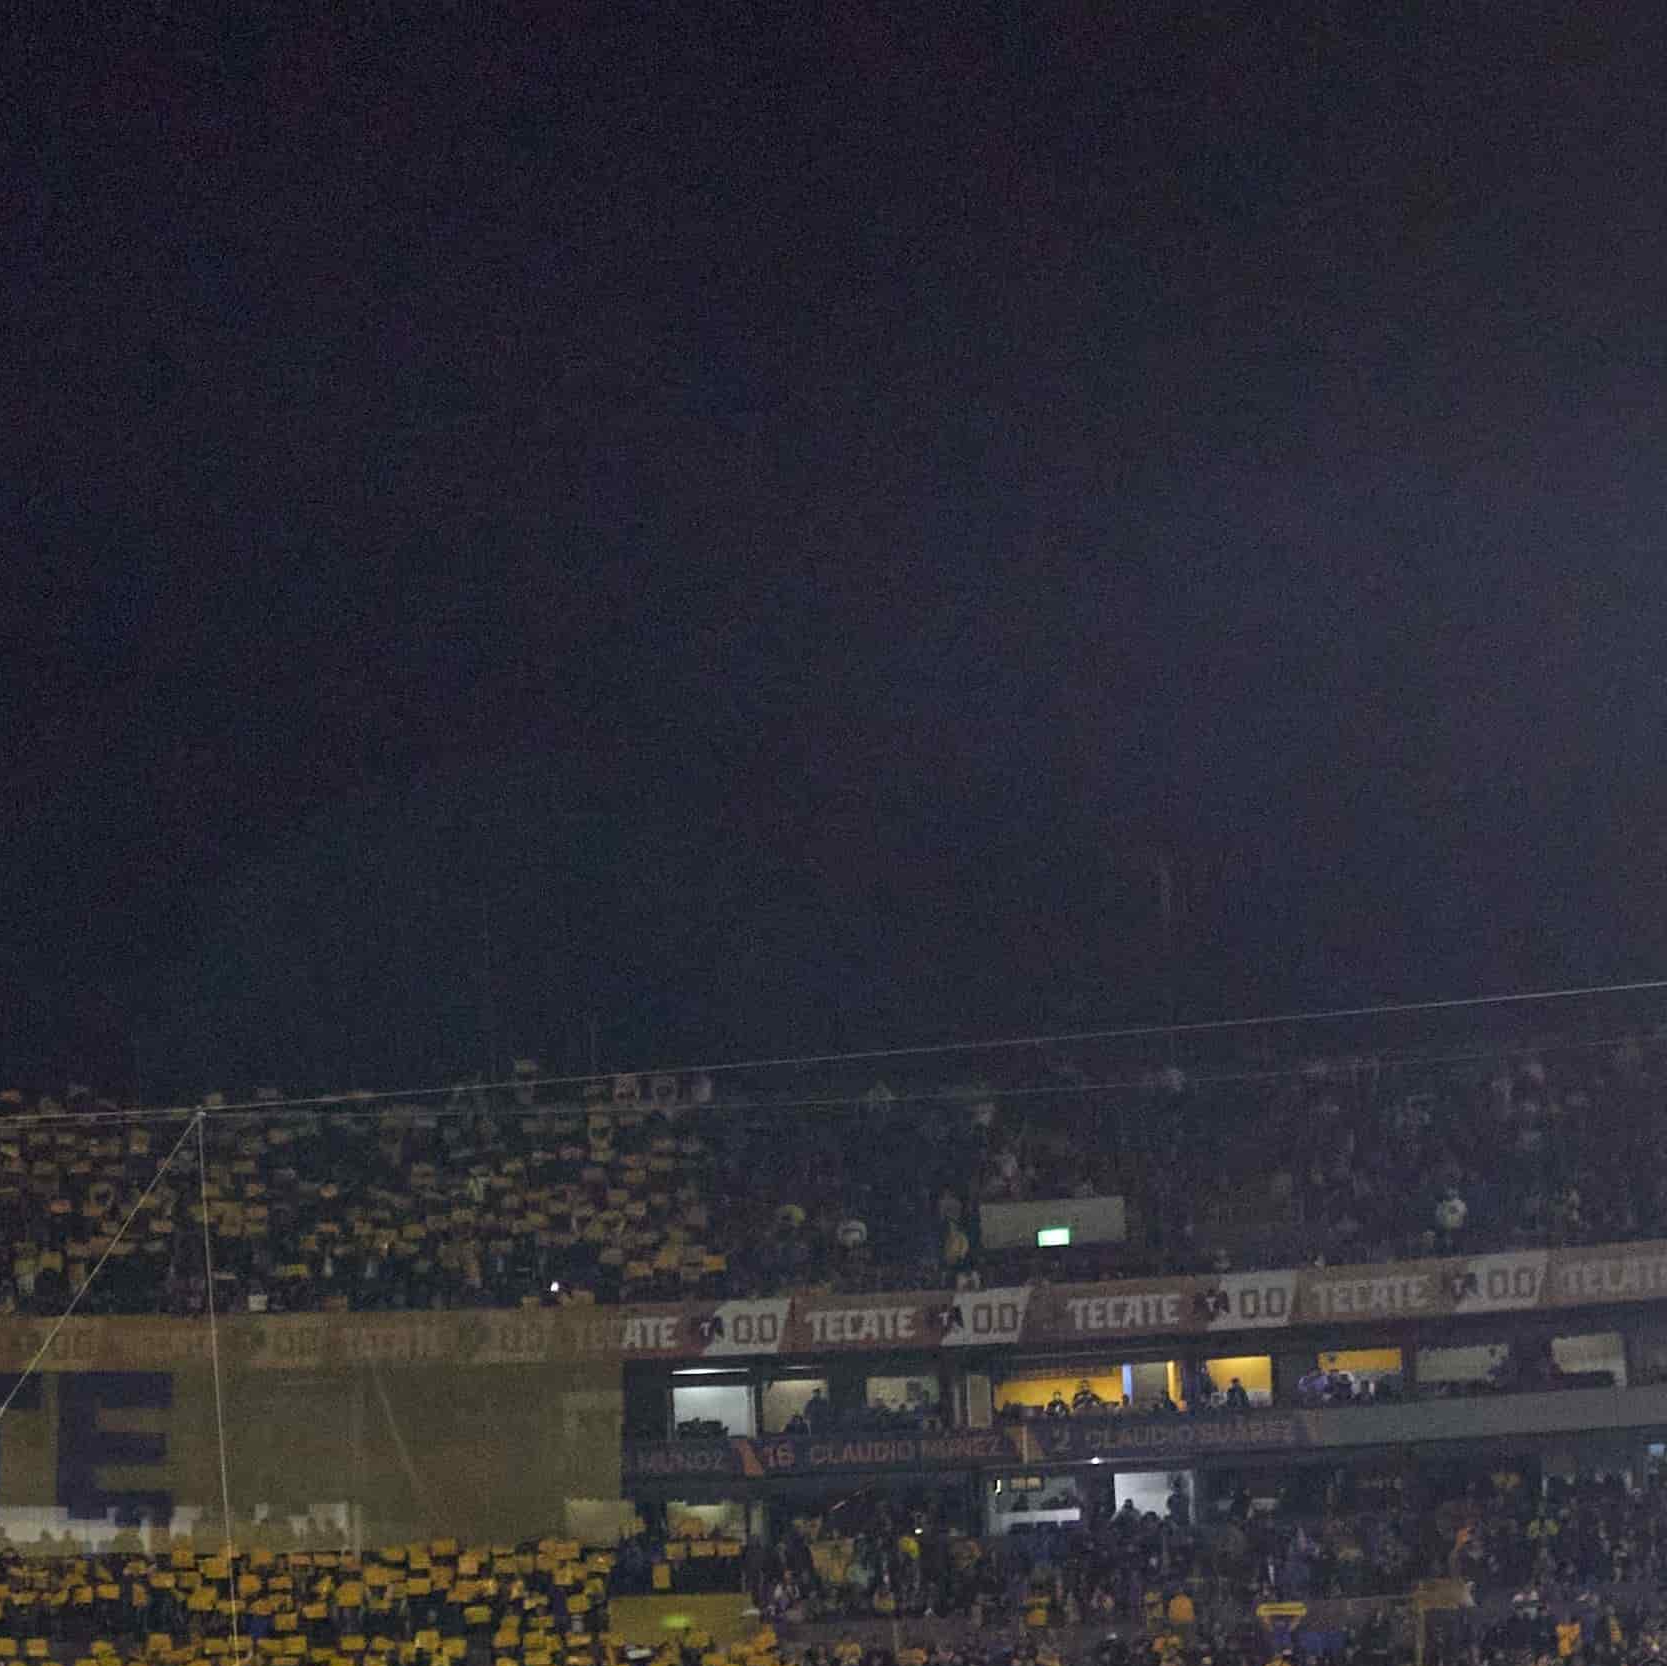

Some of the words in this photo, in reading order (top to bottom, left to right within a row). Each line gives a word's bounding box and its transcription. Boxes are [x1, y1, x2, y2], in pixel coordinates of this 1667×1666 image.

[804, 1306, 917, 1344] TECATE
[1069, 1293, 1181, 1331] TECATE
[807, 1439, 916, 1466] CLAUDIO
